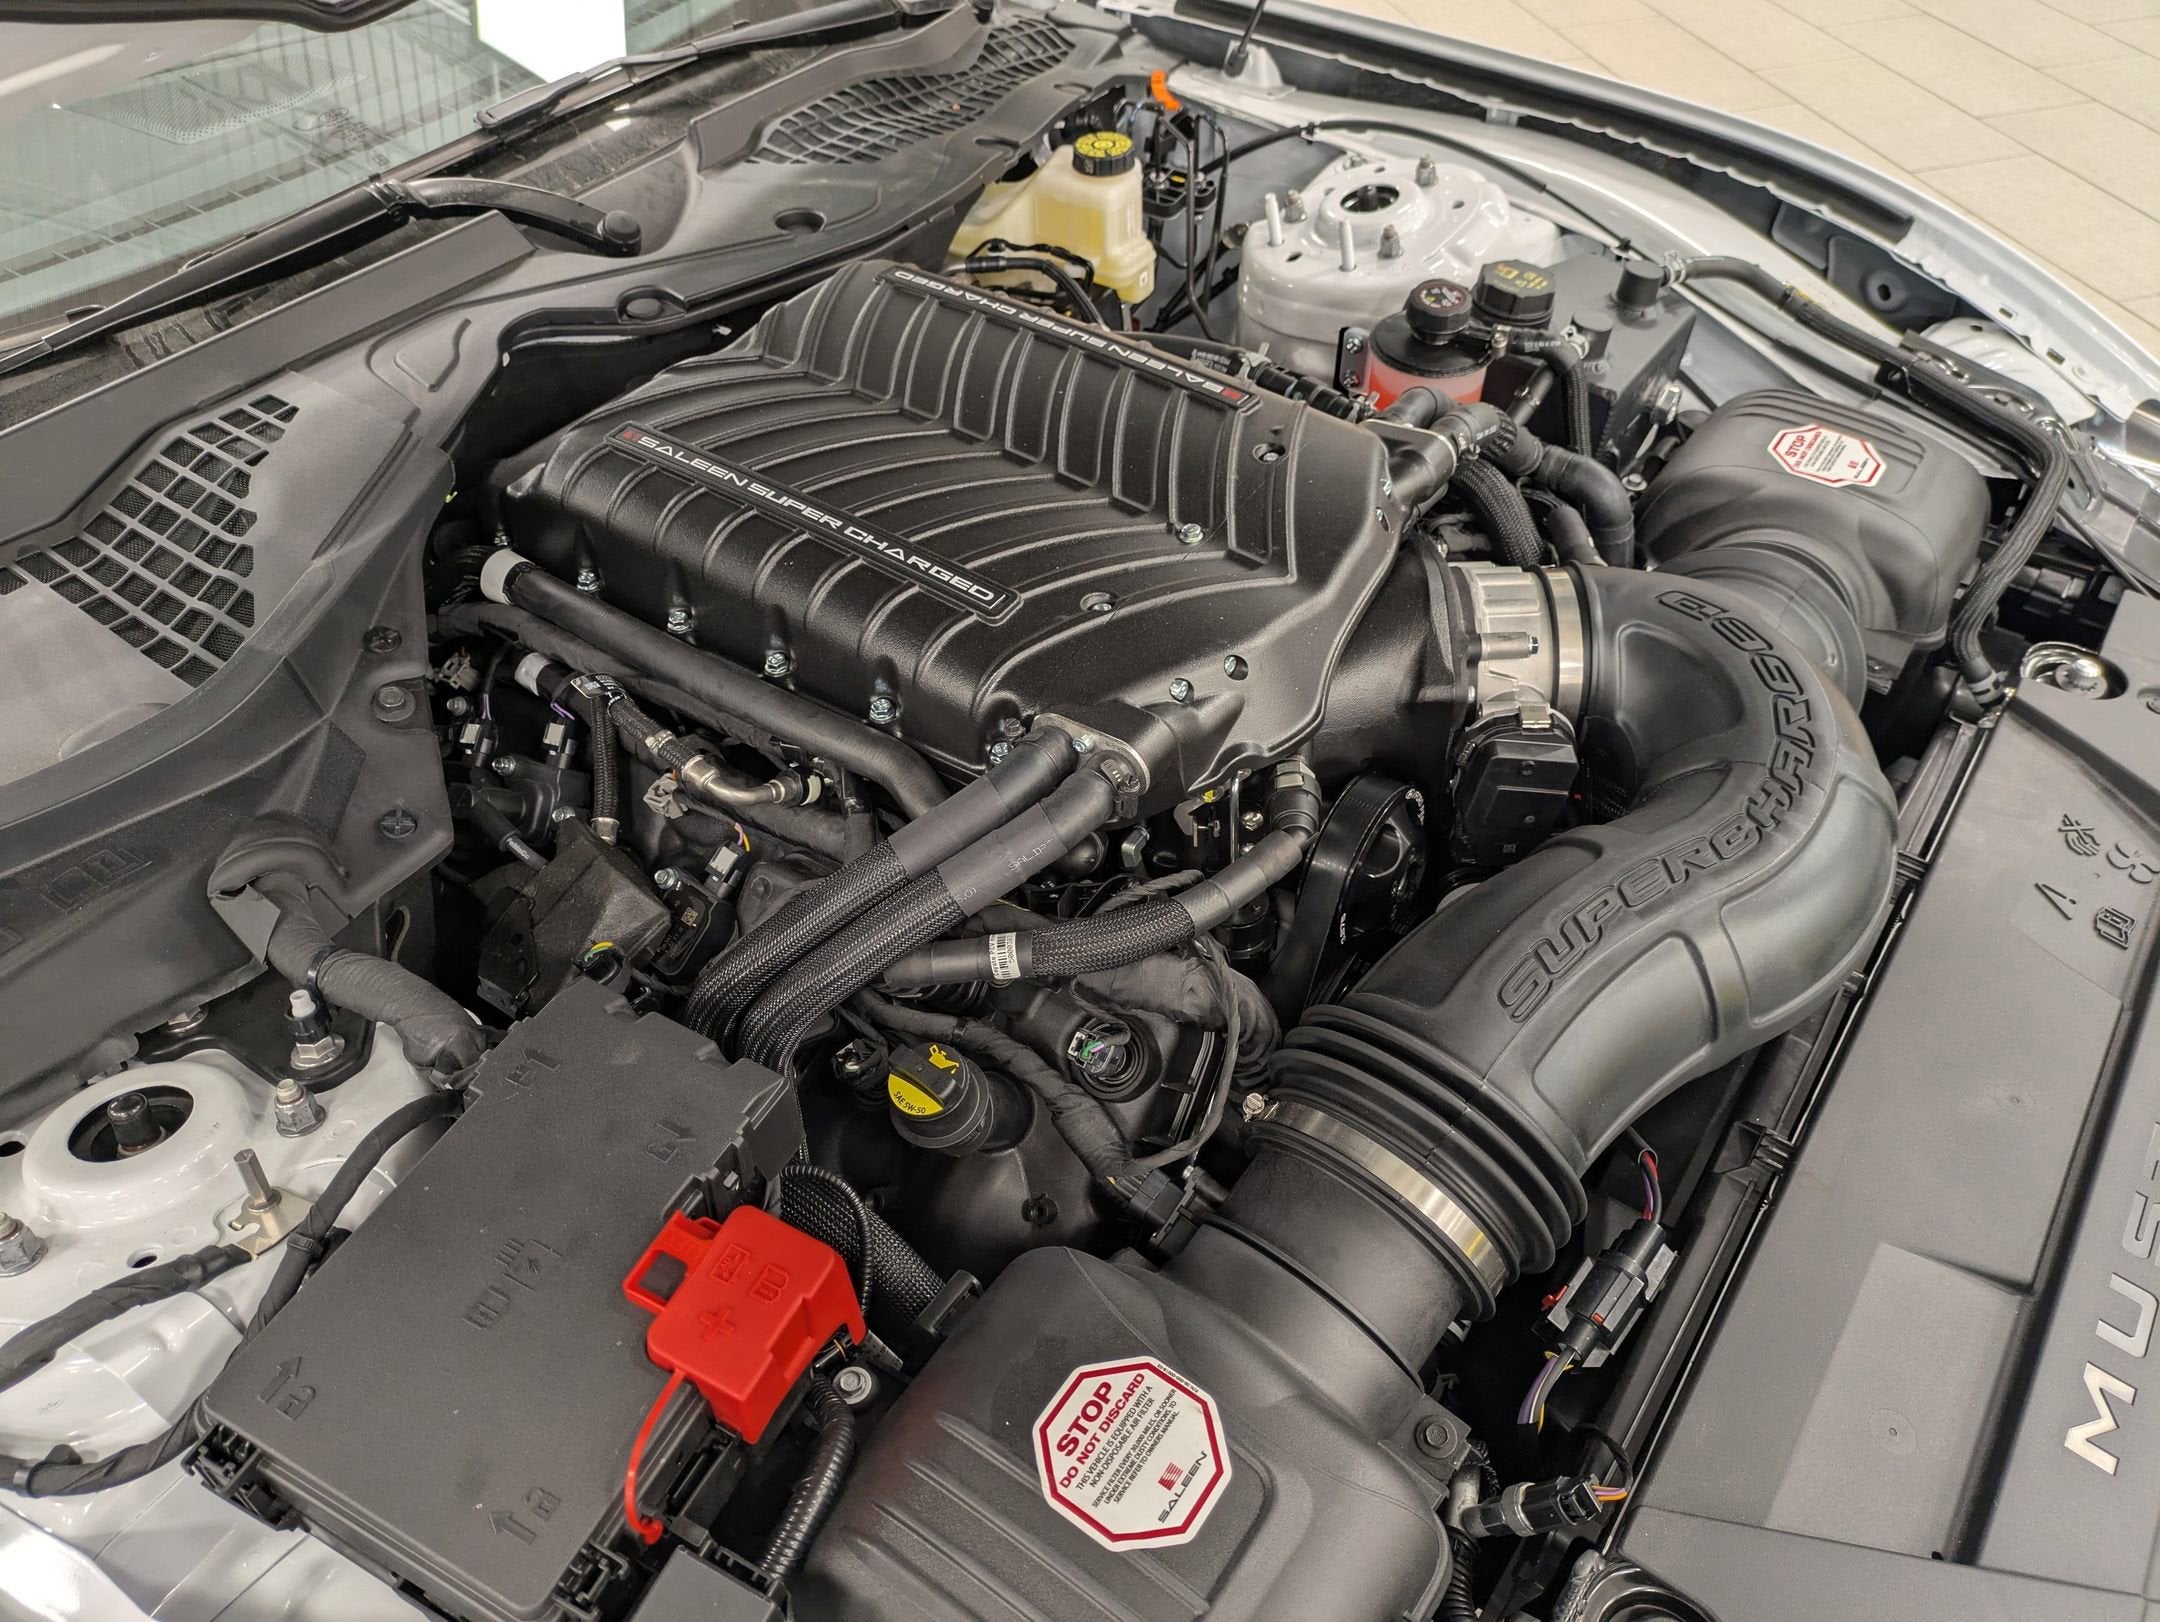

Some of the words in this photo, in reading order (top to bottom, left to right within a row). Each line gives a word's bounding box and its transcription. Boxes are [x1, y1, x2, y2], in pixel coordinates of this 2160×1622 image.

[894, 269, 1018, 317] CHARGED
[1018, 309, 1108, 349] SUPER
[1108, 342, 1224, 394] SALEEN
[1785, 434, 1805, 457] STOP
[638, 436, 748, 486] SALEEN
[747, 483, 841, 529] SUPER
[844, 526, 994, 600] CHARGED
[1497, 591, 1816, 1024] SUPERCHARGED
[893, 1091, 905, 1106] SAE
[902, 1101, 927, 1115] 5W-50
[2064, 1121, 2160, 1476] MUS
[1057, 1382, 1112, 1456] STOP
[1059, 1466, 1079, 1488] DO
[1076, 1433, 1100, 1465] NOT
[1098, 1373, 1144, 1433] DISCARD
[1075, 1473, 1090, 1490] THIS
[1086, 1446, 1110, 1474] VEHICLE
[1110, 1407, 1136, 1441] EQUIPPED
[1133, 1391, 1149, 1408] WITH
[1089, 1428, 1133, 1488] NON-DISPOSABLE
[1130, 1417, 1141, 1430] AIR
[1137, 1398, 1155, 1419] FILTER
[1104, 1484, 1120, 1504] UNDER
[1117, 1459, 1137, 1485] EXTREME
[1134, 1440, 1149, 1460] DUSTY
[1106, 1468, 1122, 1487] FILTER
[1118, 1451, 1132, 1469] EVERY
[1113, 1480, 1132, 1503] SERVICE
[1128, 1463, 1143, 1481] REFER
[1158, 1451, 1207, 1523] SALEEN
